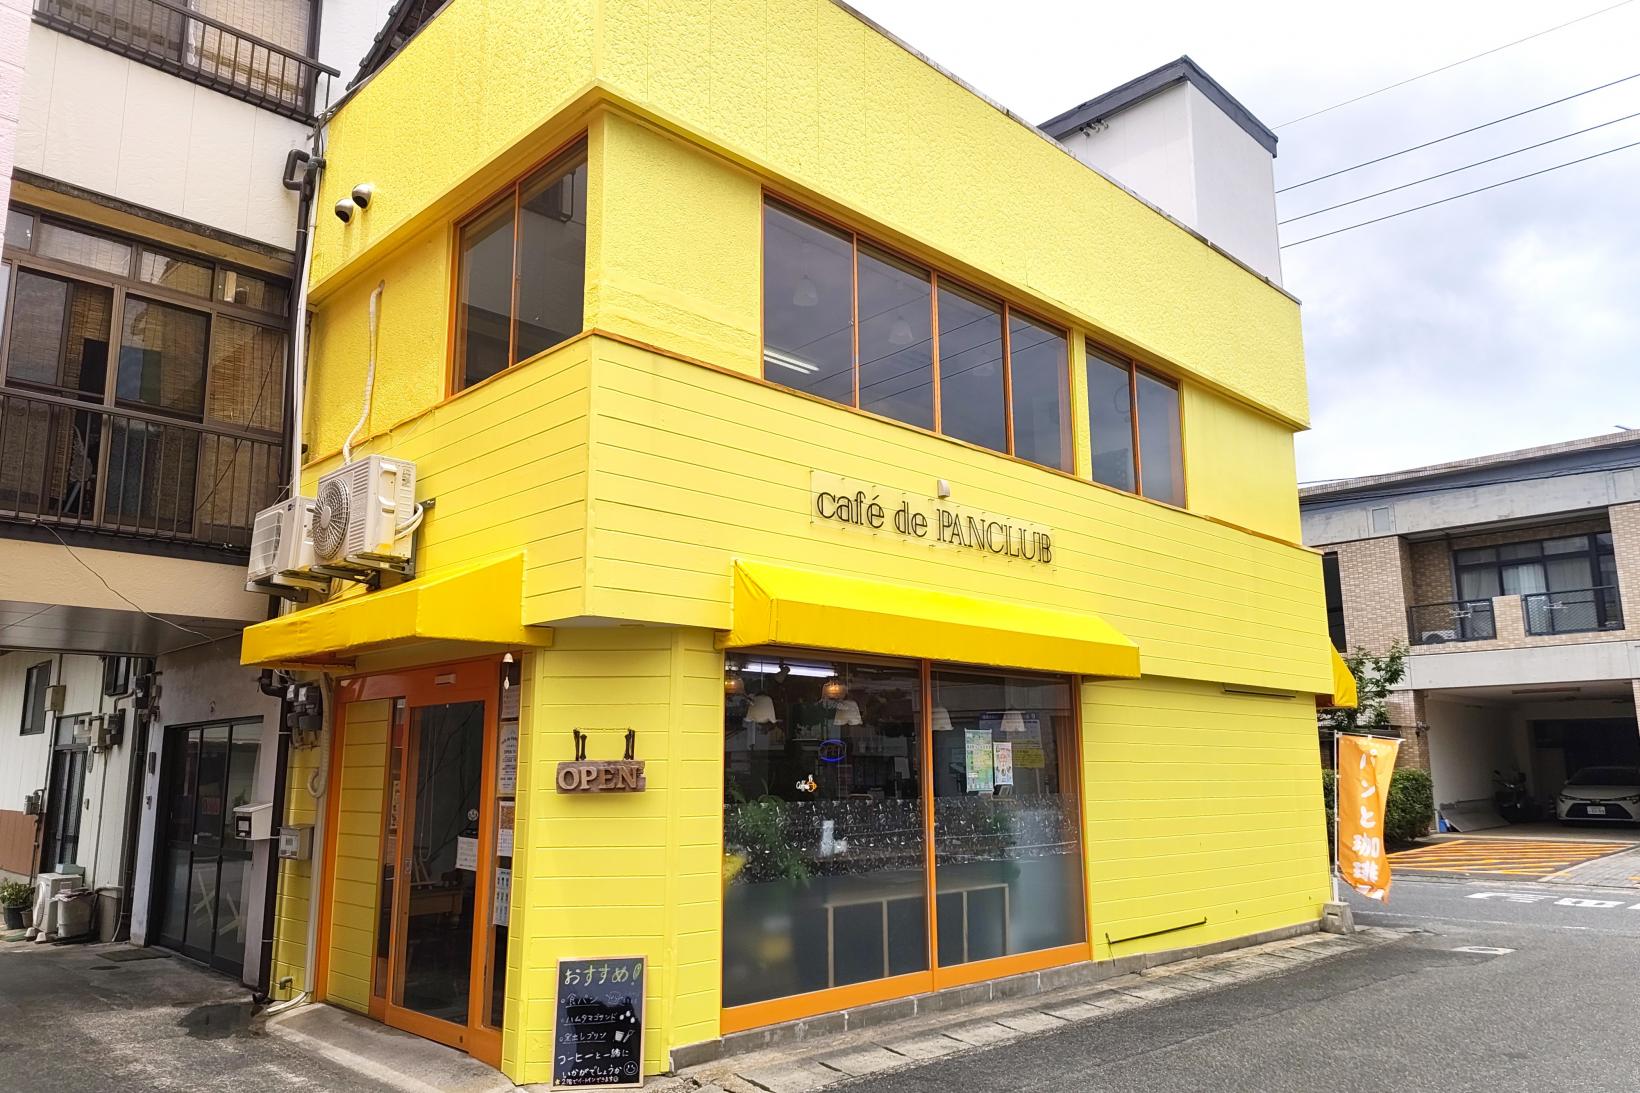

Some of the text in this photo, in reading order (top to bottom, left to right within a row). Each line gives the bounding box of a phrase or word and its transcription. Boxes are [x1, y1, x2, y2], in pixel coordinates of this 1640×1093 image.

[816, 490, 1052, 564] café de PANCLUB
[558, 765, 640, 790] OPEN
[1351, 748, 1380, 883] パンと珈琲
